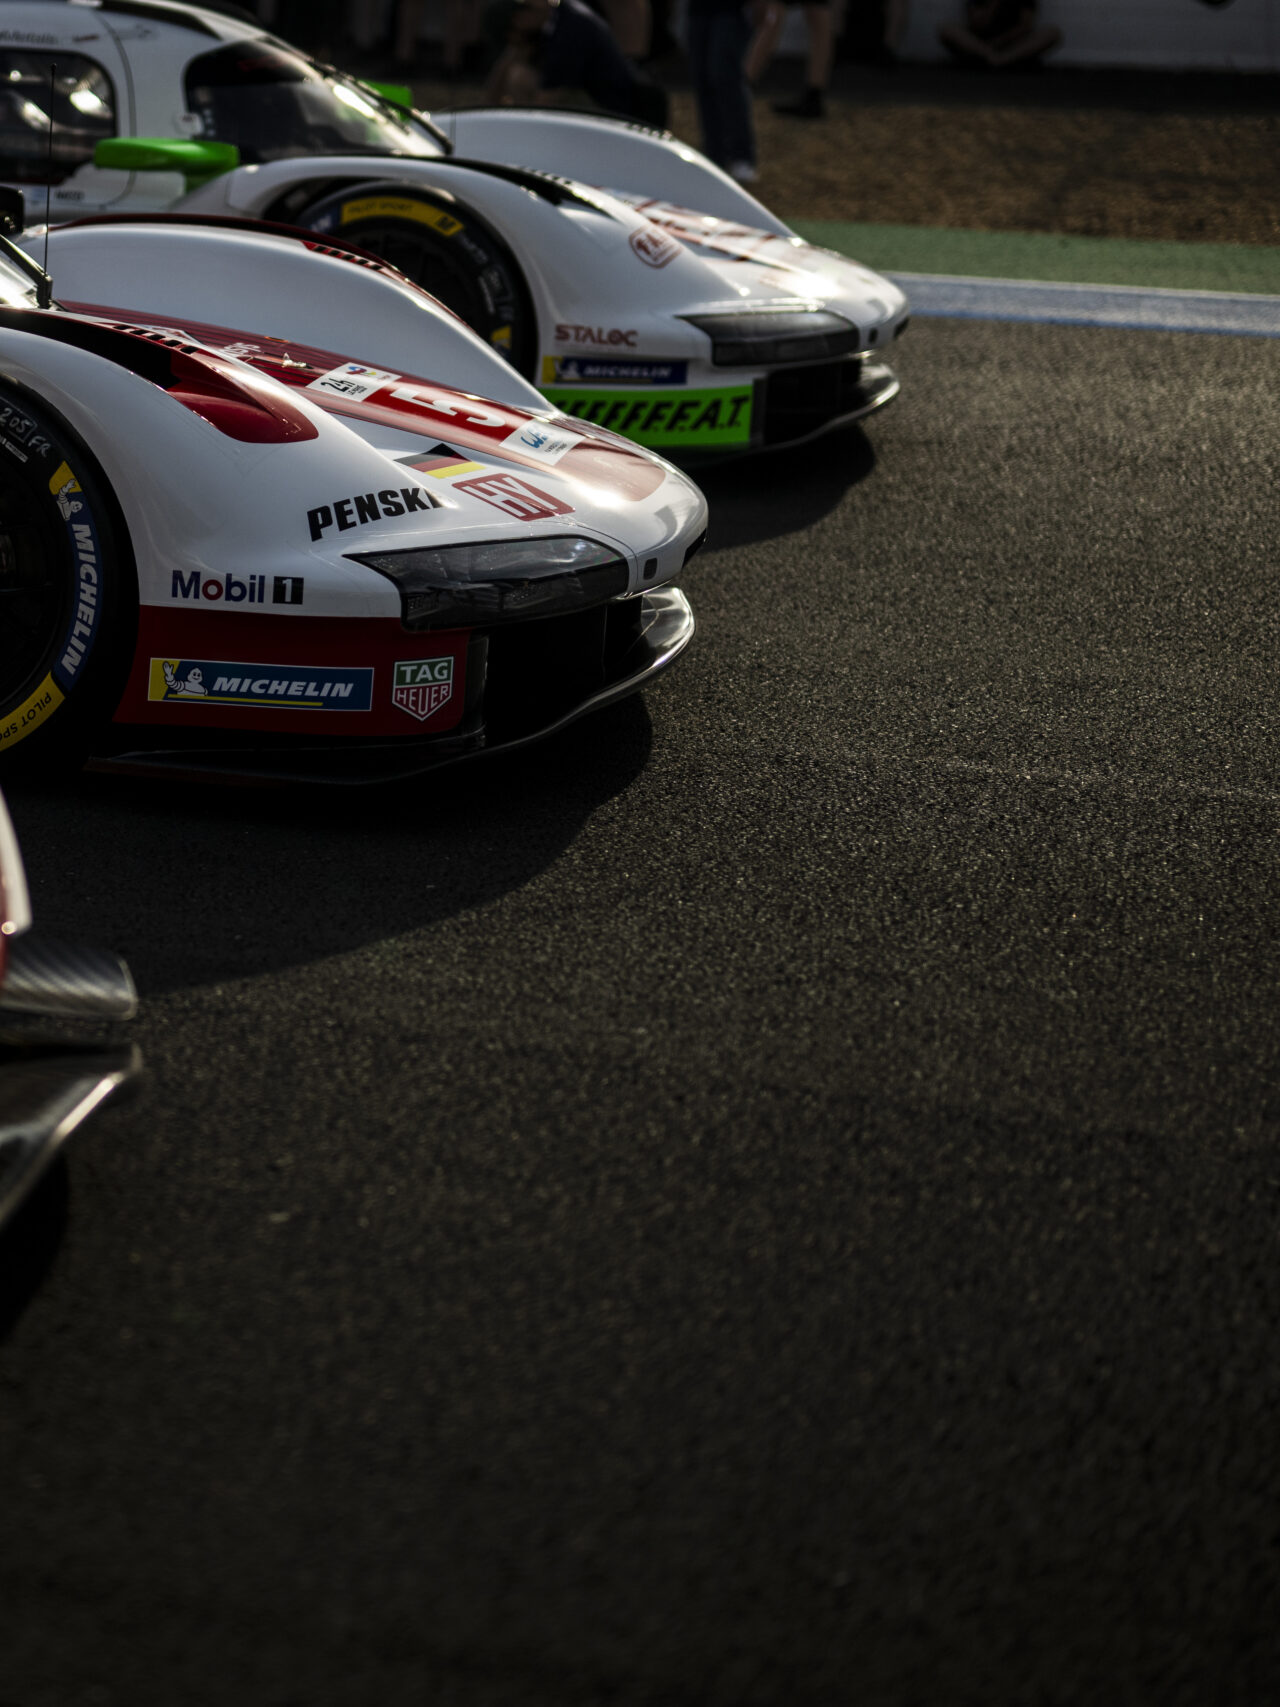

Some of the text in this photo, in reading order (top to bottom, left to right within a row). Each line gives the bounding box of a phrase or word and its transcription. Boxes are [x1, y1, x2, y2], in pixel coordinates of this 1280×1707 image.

[555, 325, 638, 347] STALOC
[582, 364, 673, 379] MICHELIN
[461, 476, 560, 518] HY
[61, 523, 97, 676] MICHELIN
[171, 570, 266, 604] Mobil
[212, 676, 354, 698] MICHELIN
[399, 661, 449, 684] TAG
[21, 692, 53, 727] PILOT
[395, 685, 450, 715] HEUER
